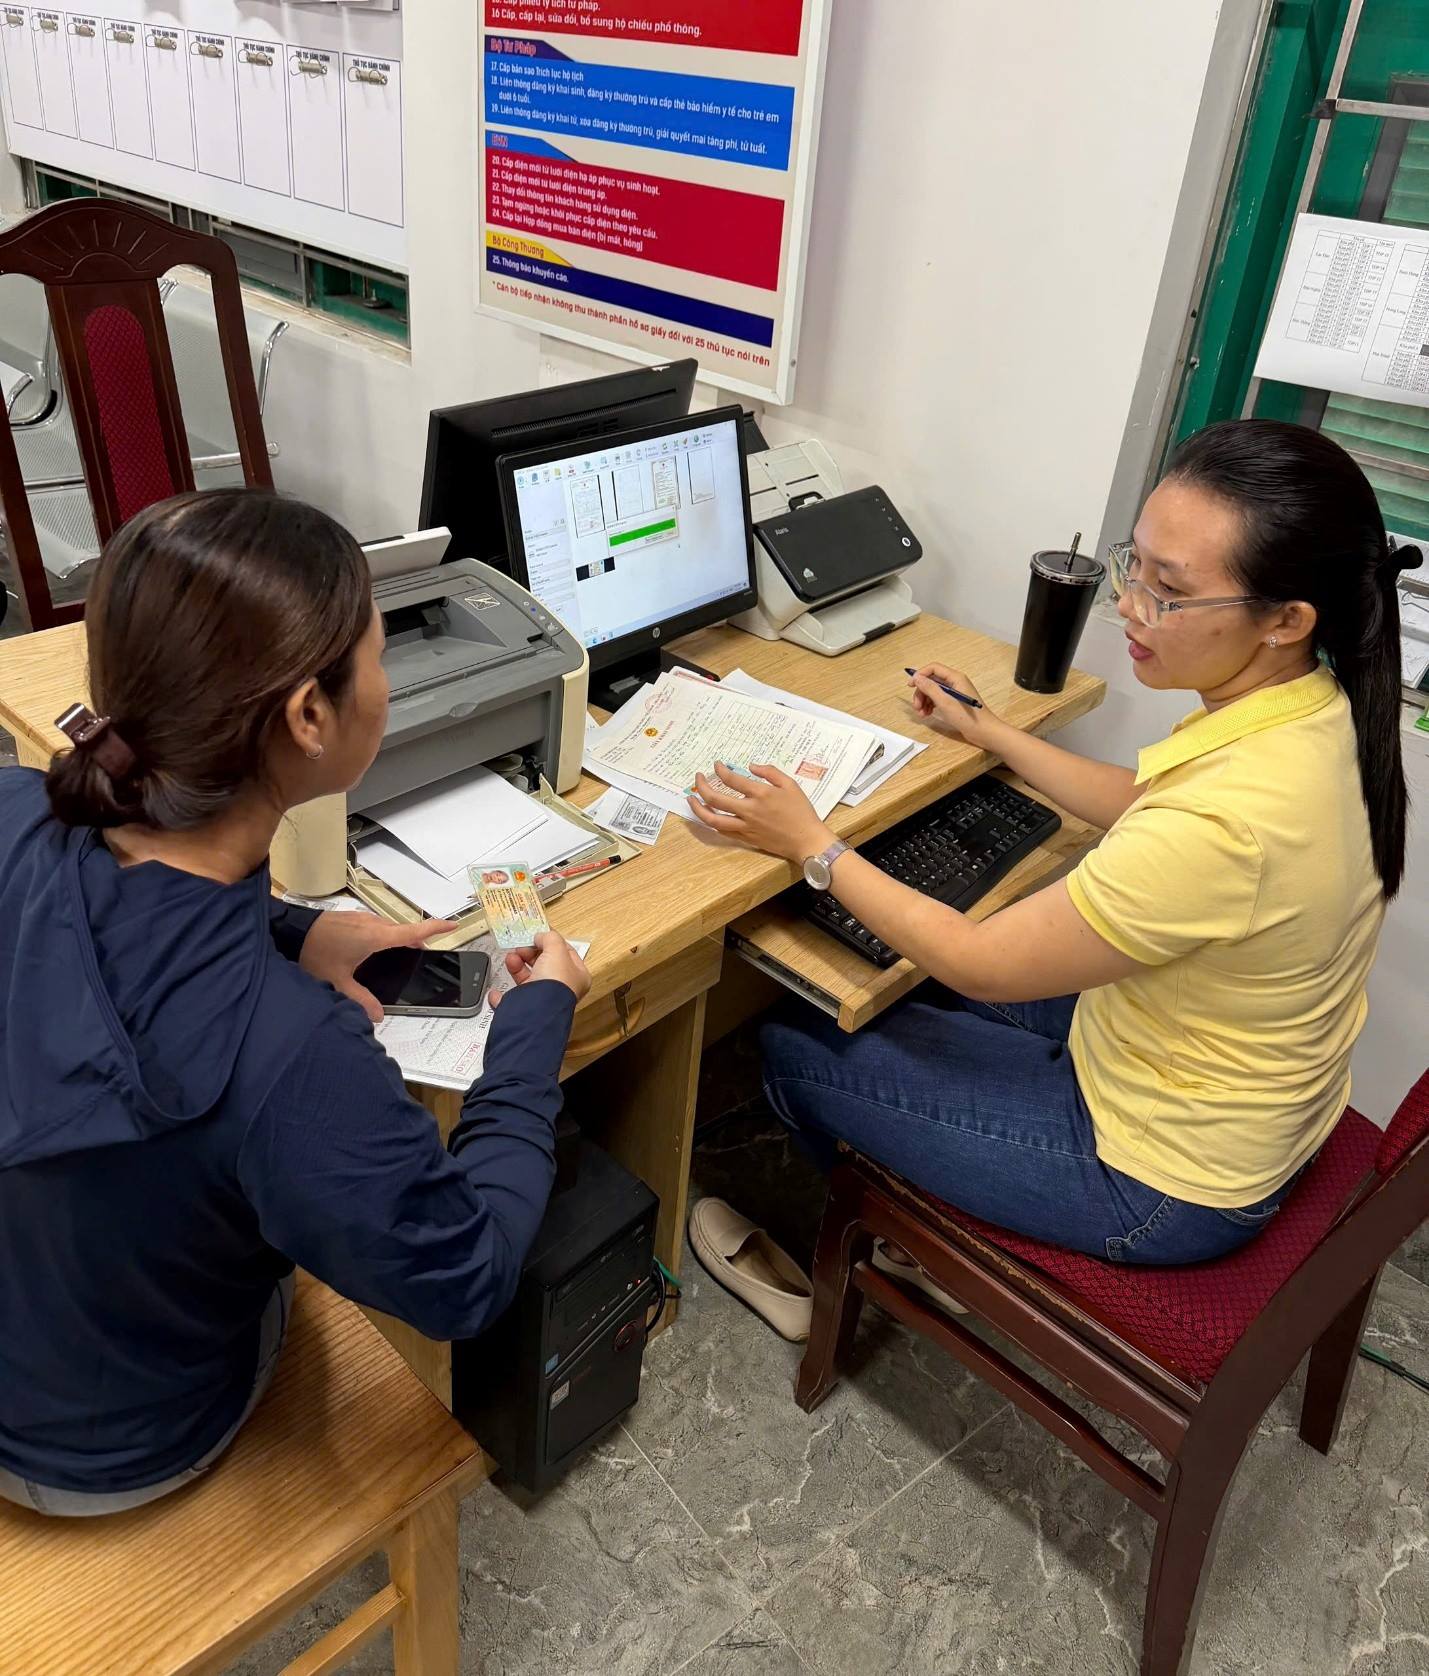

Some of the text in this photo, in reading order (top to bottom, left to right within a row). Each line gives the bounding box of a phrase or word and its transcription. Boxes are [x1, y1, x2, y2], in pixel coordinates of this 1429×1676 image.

[592, 18, 613, 30] sung
[722, 107, 726, 118] y
[738, 108, 752, 119] cho
[766, 113, 780, 124] em
[578, 183, 596, 198] trung
[626, 178, 641, 191] sinh
[612, 218, 628, 233] theo
[575, 302, 586, 314] thu
[696, 337, 705, 348] 25
[722, 345, 735, 358] tục
